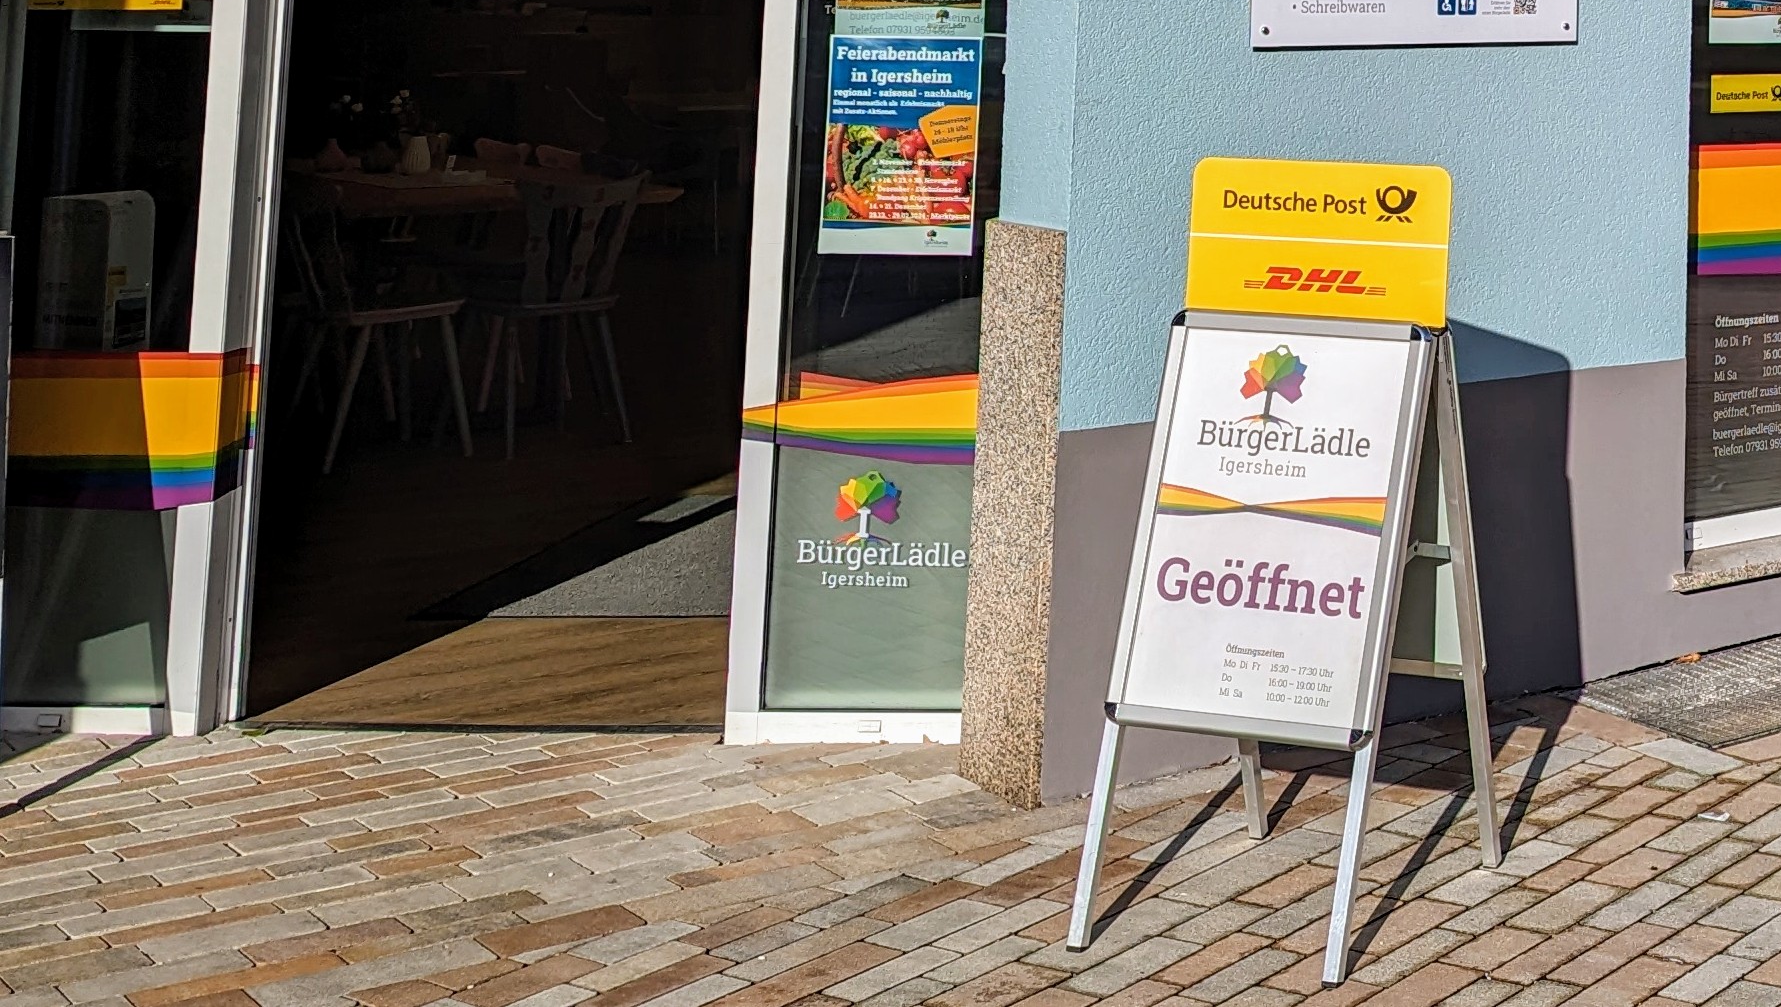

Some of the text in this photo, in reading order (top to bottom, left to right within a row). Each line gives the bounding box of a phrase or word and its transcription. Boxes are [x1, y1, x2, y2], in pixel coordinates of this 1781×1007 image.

[1301, 0, 1386, 14] Schreibwaren
[836, 45, 976, 62] Feierabendmarkt
[851, 67, 953, 85] in Igersheim
[833, 88, 973, 100] regional saisonal nachhaltig
[1716, 90, 1751, 101] Deutsche
[1752, 90, 1769, 100] Post
[1223, 189, 1367, 215] Deutsche Post
[1262, 266, 1367, 295] DHL
[1714, 314, 1780, 329] Öffnungszeiten
[1714, 337, 1728, 349] Mo
[1730, 335, 1739, 347] Di
[1742, 334, 1752, 346] Fr
[1714, 354, 1727, 366] Do
[1714, 371, 1725, 382] Mi
[1726, 370, 1738, 381] Sa
[1713, 386, 1758, 403] Bürgertreff
[1713, 405, 1749, 422] geöffnet,
[1197, 418, 1371, 458] BürgerLädle
[1713, 442, 1744, 457] Telefon
[1746, 439, 1768, 453] 07931
[1219, 456, 1306, 478] Igersheim
[797, 539, 967, 571] BürgerLädle
[821, 571, 908, 589] Igersheim
[1156, 556, 1365, 620] Geöffnet
[1225, 643, 1285, 659] Öffnungszeiten
[1223, 658, 1237, 668] Mo
[1240, 660, 1248, 669] Di
[1252, 661, 1261, 671] Fr
[1319, 668, 1334, 678] Uhr
[1221, 673, 1232, 682] Do
[1317, 682, 1333, 693] Uhr
[1219, 687, 1230, 697] Mi
[1233, 688, 1243, 698] Sa
[1315, 697, 1331, 708] Uhr
